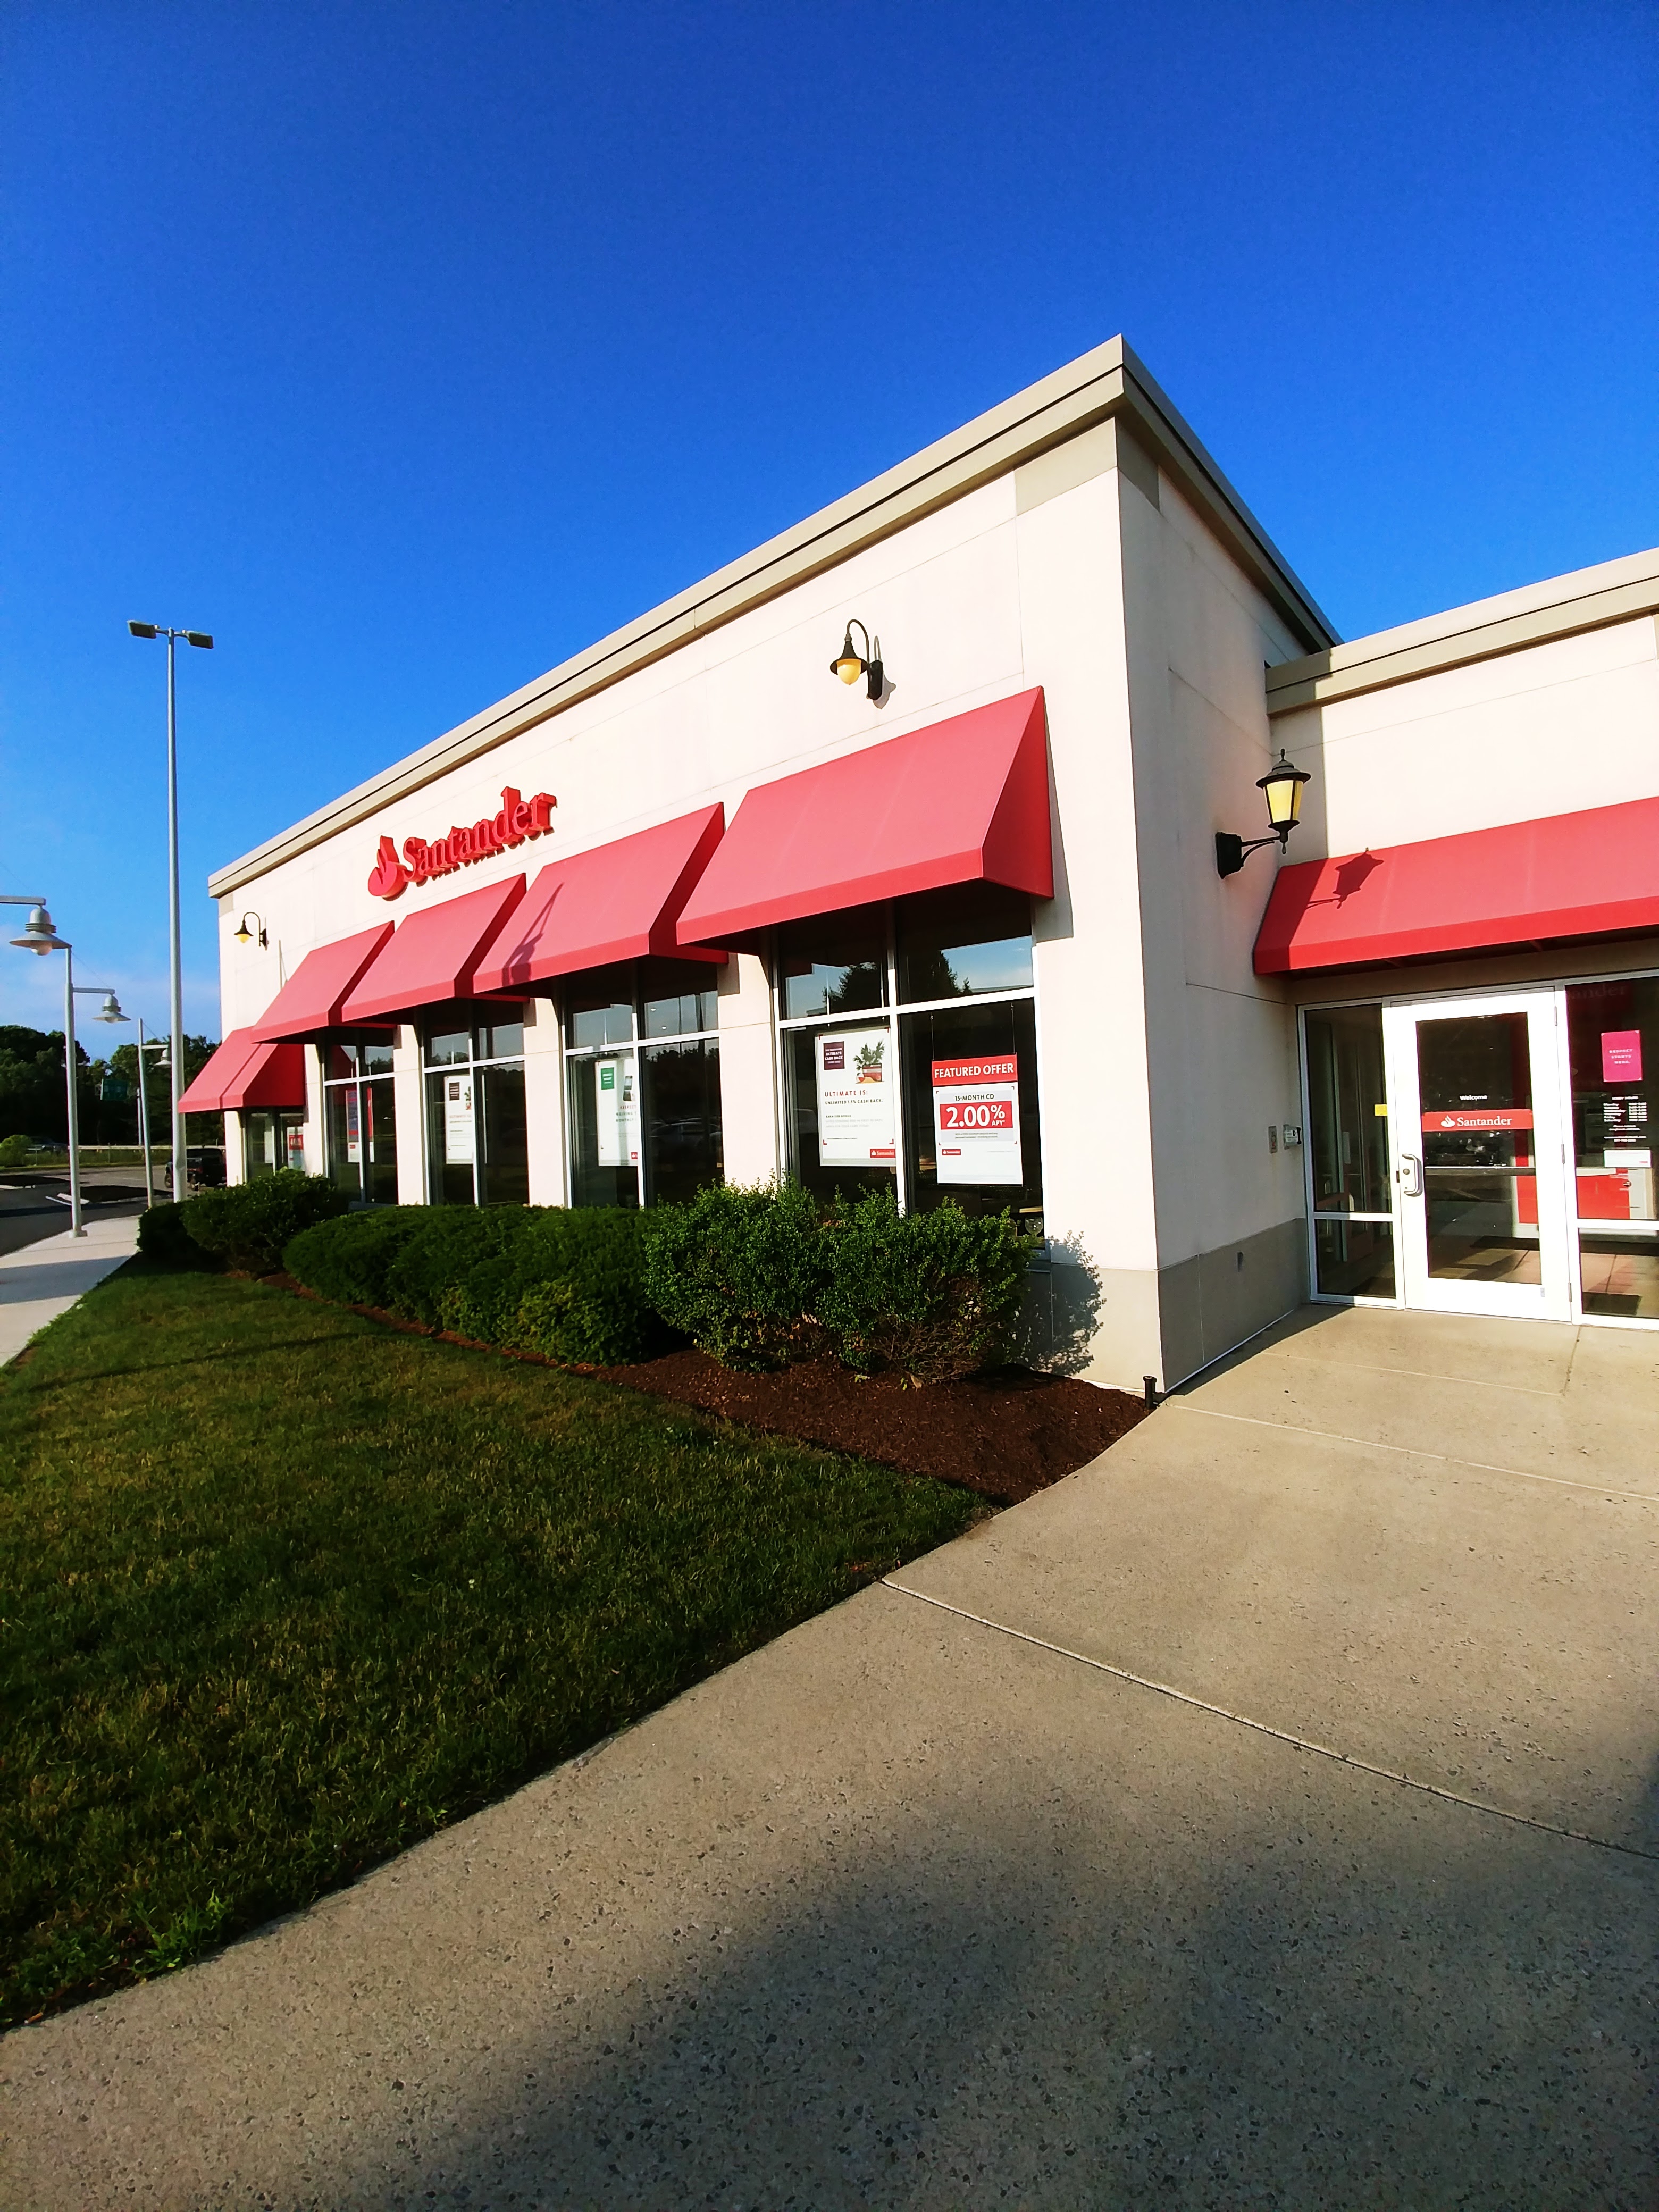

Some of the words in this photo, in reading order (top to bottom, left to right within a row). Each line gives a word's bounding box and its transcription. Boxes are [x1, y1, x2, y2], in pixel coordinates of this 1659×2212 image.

[402, 786, 557, 881] Santander
[934, 1066, 981, 1078] FEATURED
[983, 1063, 1014, 1075] OFFER
[946, 1104, 1006, 1127] 2.00%
[1457, 1115, 1512, 1127] Santander
